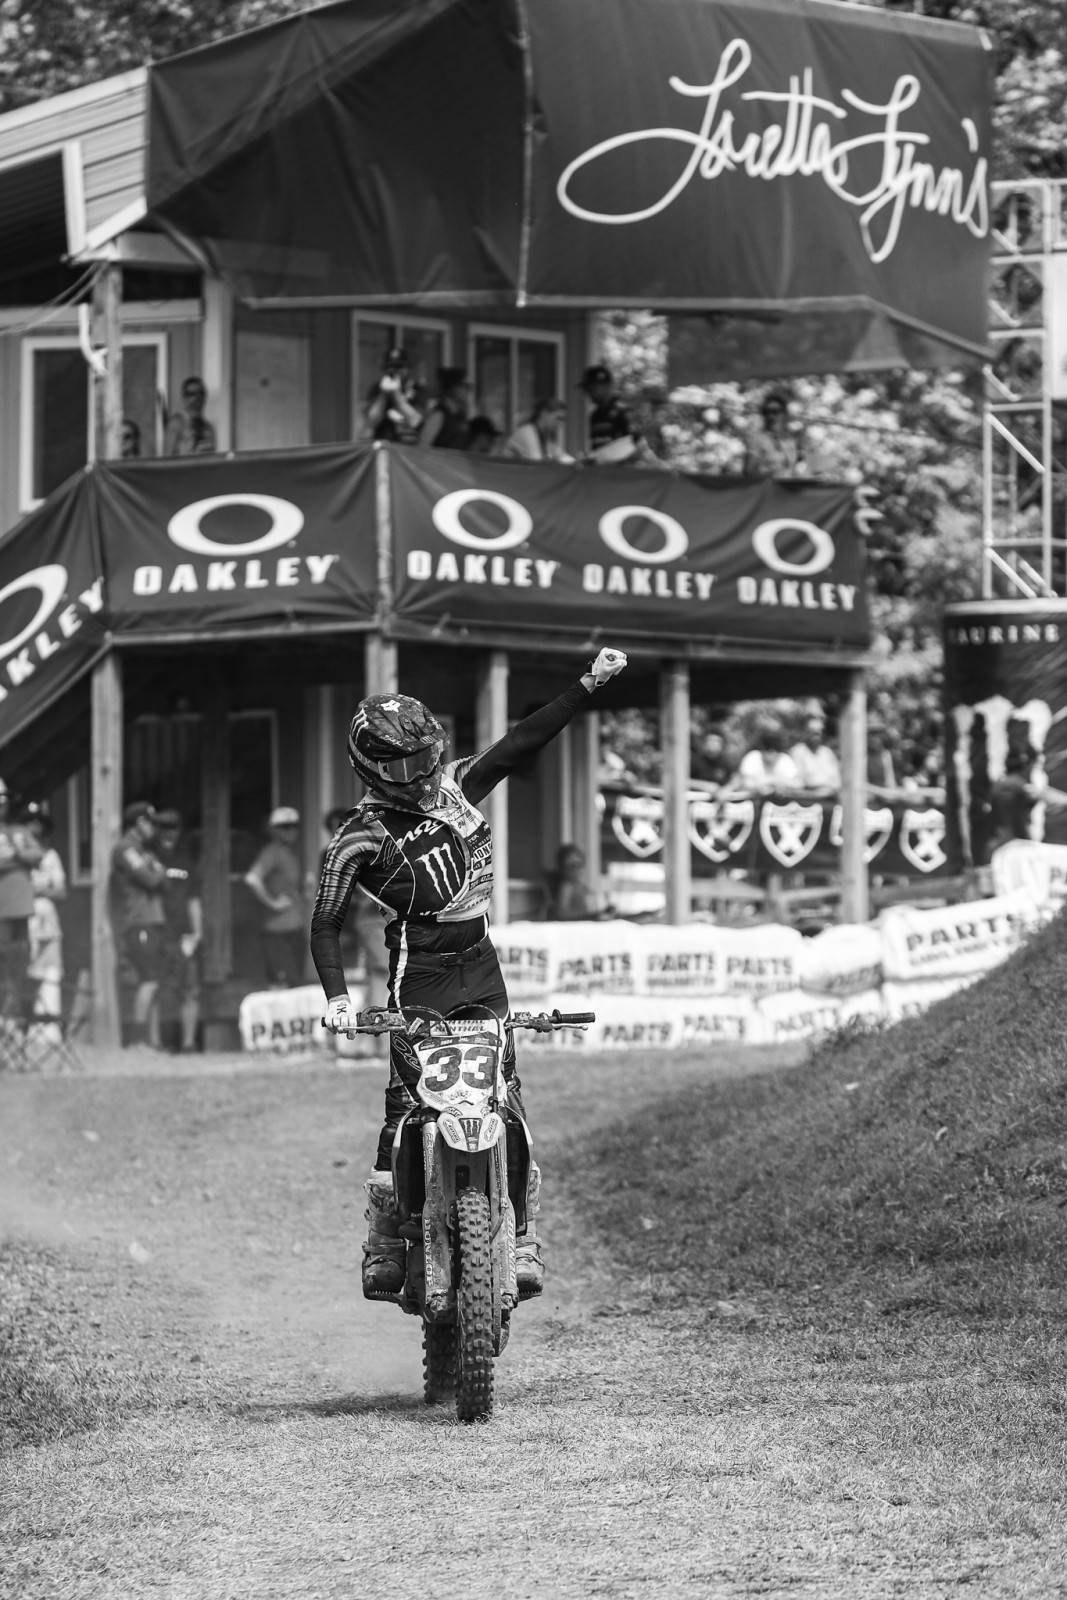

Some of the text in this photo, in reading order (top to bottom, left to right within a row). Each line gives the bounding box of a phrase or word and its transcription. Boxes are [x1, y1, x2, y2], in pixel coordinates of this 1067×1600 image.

[133, 555, 335, 596] OAKLEY
[407, 550, 556, 589] OAKLEY
[583, 563, 715, 601] OAKLEY
[736, 576, 856, 612] OAKLEY
[948, 624, 1061, 645] AURINE
[494, 946, 549, 967] ARTS
[557, 951, 633, 979] PARTS
[646, 952, 715, 972] PARTS
[726, 955, 794, 976] PARTS
[424, 1046, 497, 1092] 33
